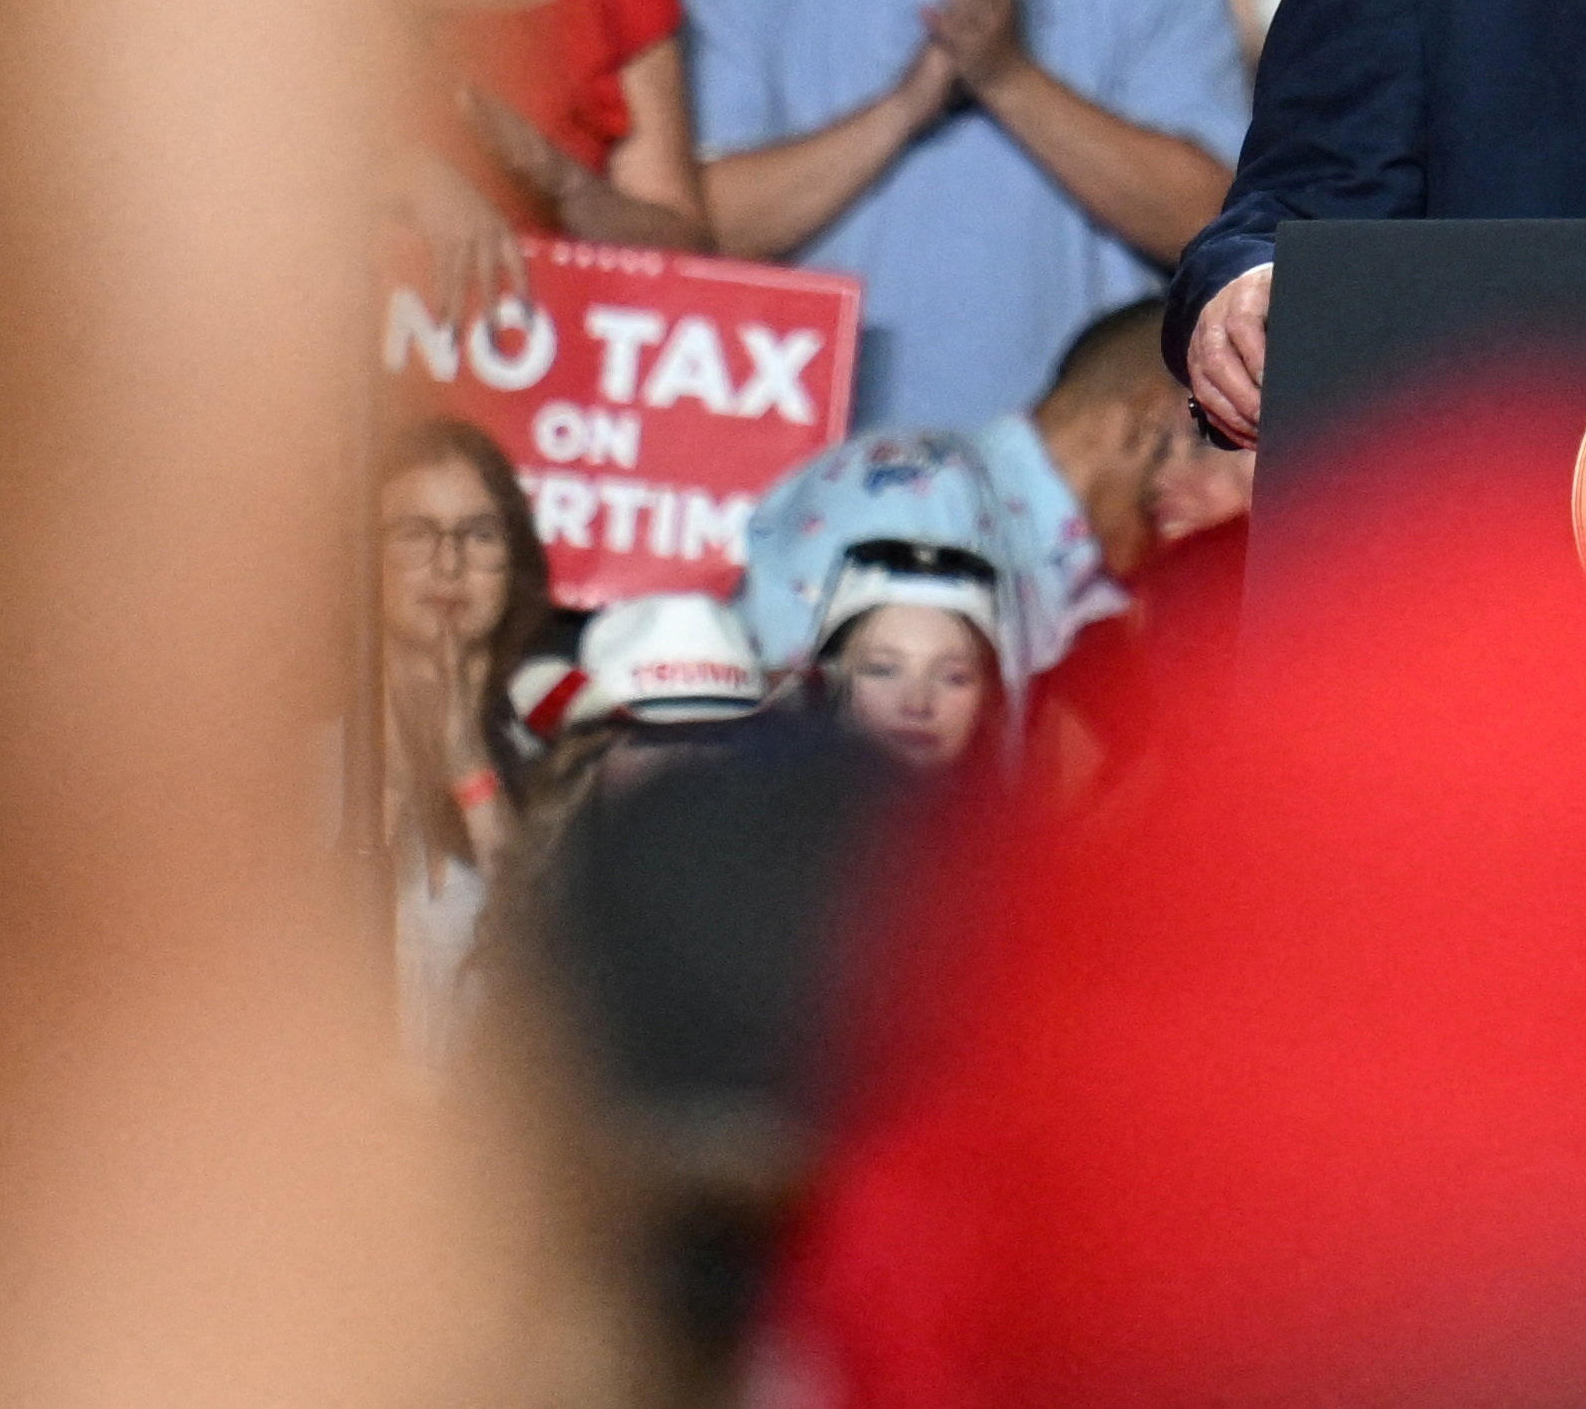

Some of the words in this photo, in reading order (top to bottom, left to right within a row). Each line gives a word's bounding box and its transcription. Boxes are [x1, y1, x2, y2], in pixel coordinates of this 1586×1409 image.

[383, 287, 558, 392] NO
[584, 302, 824, 427] TAX
[531, 401, 643, 470] ON
